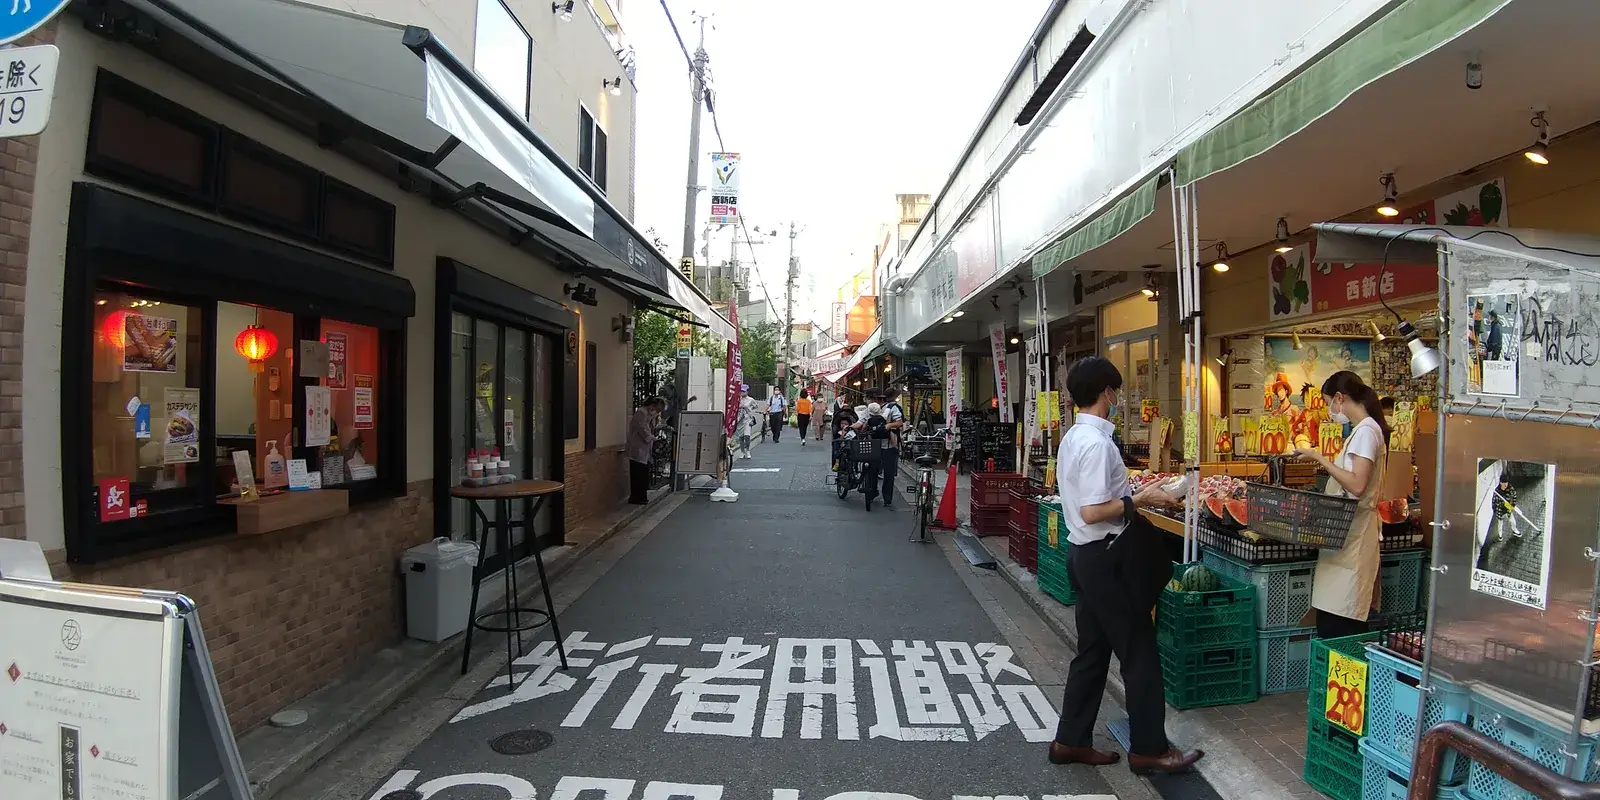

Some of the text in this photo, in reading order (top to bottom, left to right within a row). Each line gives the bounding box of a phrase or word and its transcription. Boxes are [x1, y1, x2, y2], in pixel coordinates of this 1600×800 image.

[0, 60, 41, 89] 除く
[712, 196, 737, 205] 西新店
[1346, 271, 1395, 301] 西新店
[167, 402, 198, 411] カステラサンド
[1260, 432, 1286, 455] 100
[448, 631, 1059, 743] 歩行者用道路
[1329, 660, 1360, 688] パイン
[1326, 679, 1363, 732] 298
[65, 735, 76, 800] お家でも
